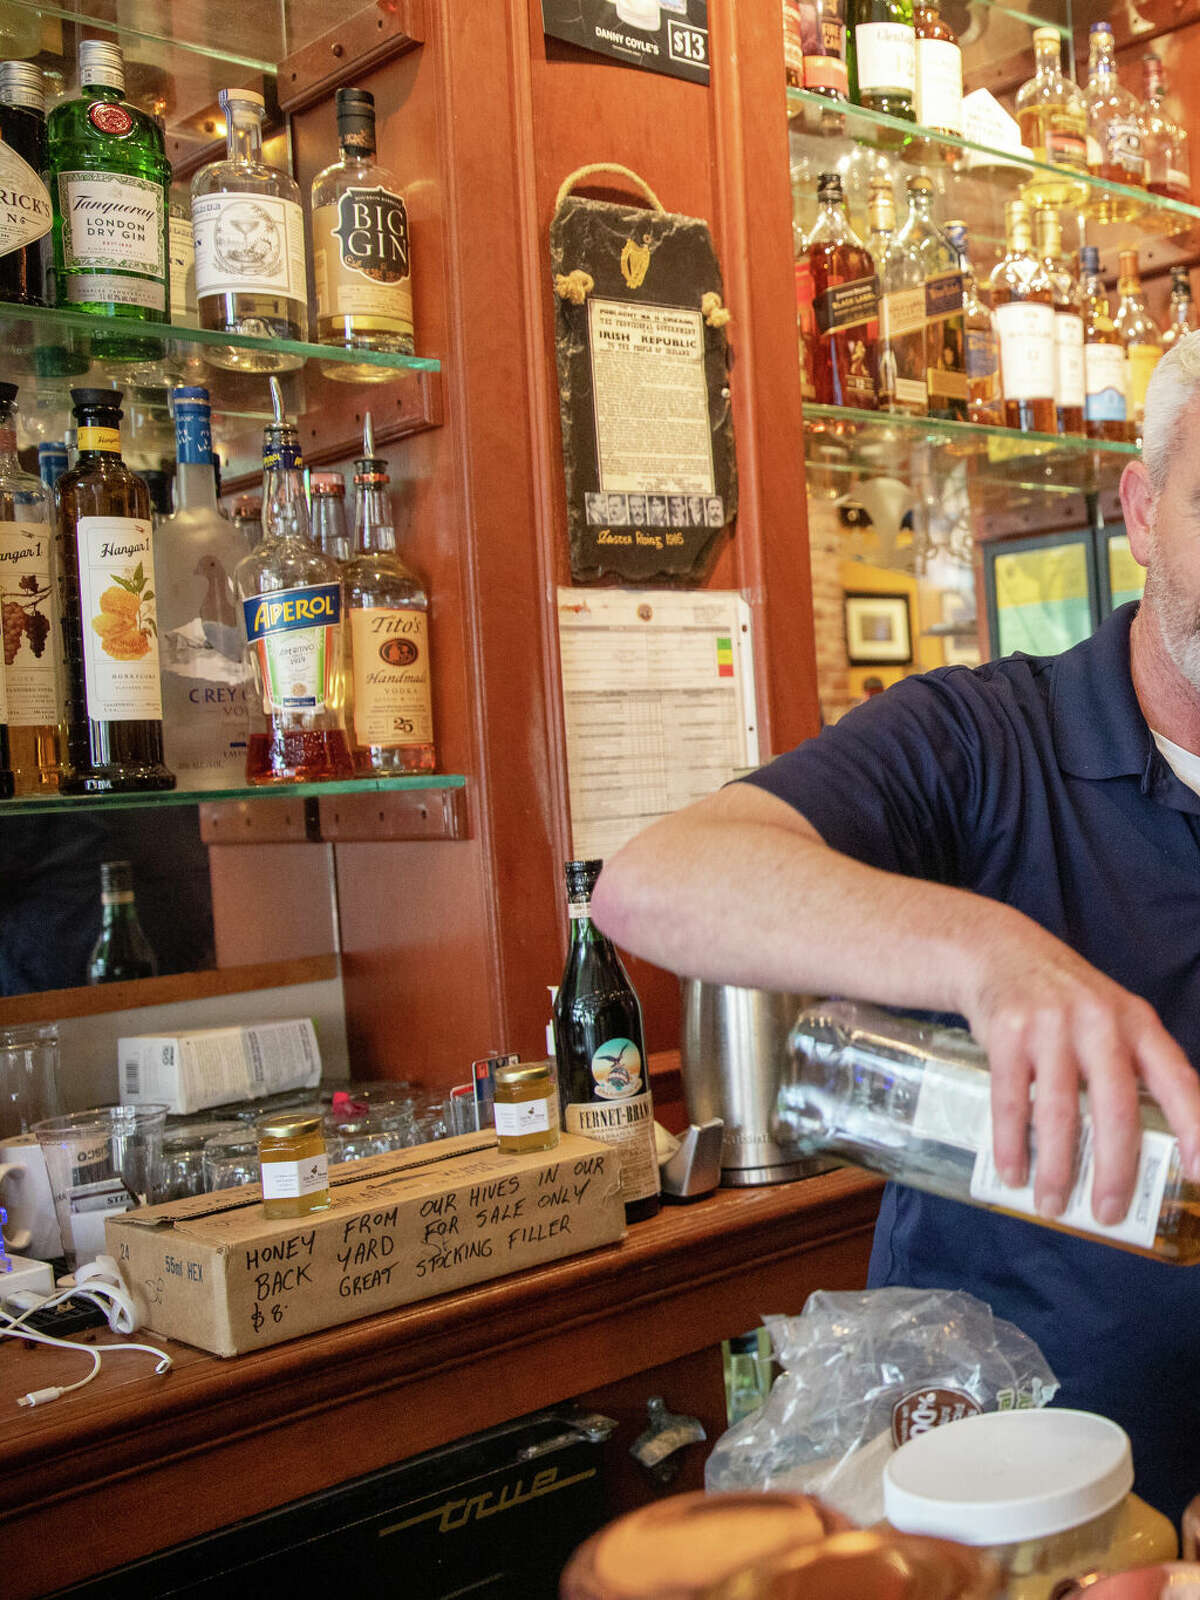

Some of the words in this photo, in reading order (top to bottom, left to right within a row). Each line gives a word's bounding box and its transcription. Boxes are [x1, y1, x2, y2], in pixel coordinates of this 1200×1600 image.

[595, 26, 625, 44] DANNY
[625, 33, 660, 55] COYLE'S
[673, 30, 706, 61] $13
[73, 195, 154, 221] Tanqueray
[352, 202, 405, 237] BIG
[87, 217, 145, 231] LONDON
[87, 227, 115, 237] DRY
[121, 230, 145, 241] GIN
[347, 229, 408, 264] GIN
[599, 330, 630, 341] IRISH
[641, 334, 697, 348] REPUBLIC
[253, 595, 335, 632] APEROL
[371, 615, 422, 634] Tito's
[393, 716, 414, 734] 25
[246, 1230, 316, 1271] HONEY
[344, 1207, 399, 1243] FROM
[420, 1193, 457, 1217] OUR
[470, 1176, 520, 1208] HIVES
[538, 1163, 560, 1187] IN
[574, 1156, 605, 1176] OUR
[255, 1262, 313, 1301] BACK
[337, 1235, 395, 1272] YARD
[422, 1216, 459, 1244] FOR
[476, 1197, 526, 1229] SALE
[538, 1178, 591, 1209] ONLY
[339, 1261, 399, 1297] GREAT
[416, 1238, 493, 1278] STOCKING
[508, 1214, 573, 1250] FILLER
[187, 1261, 204, 1283] HEX
